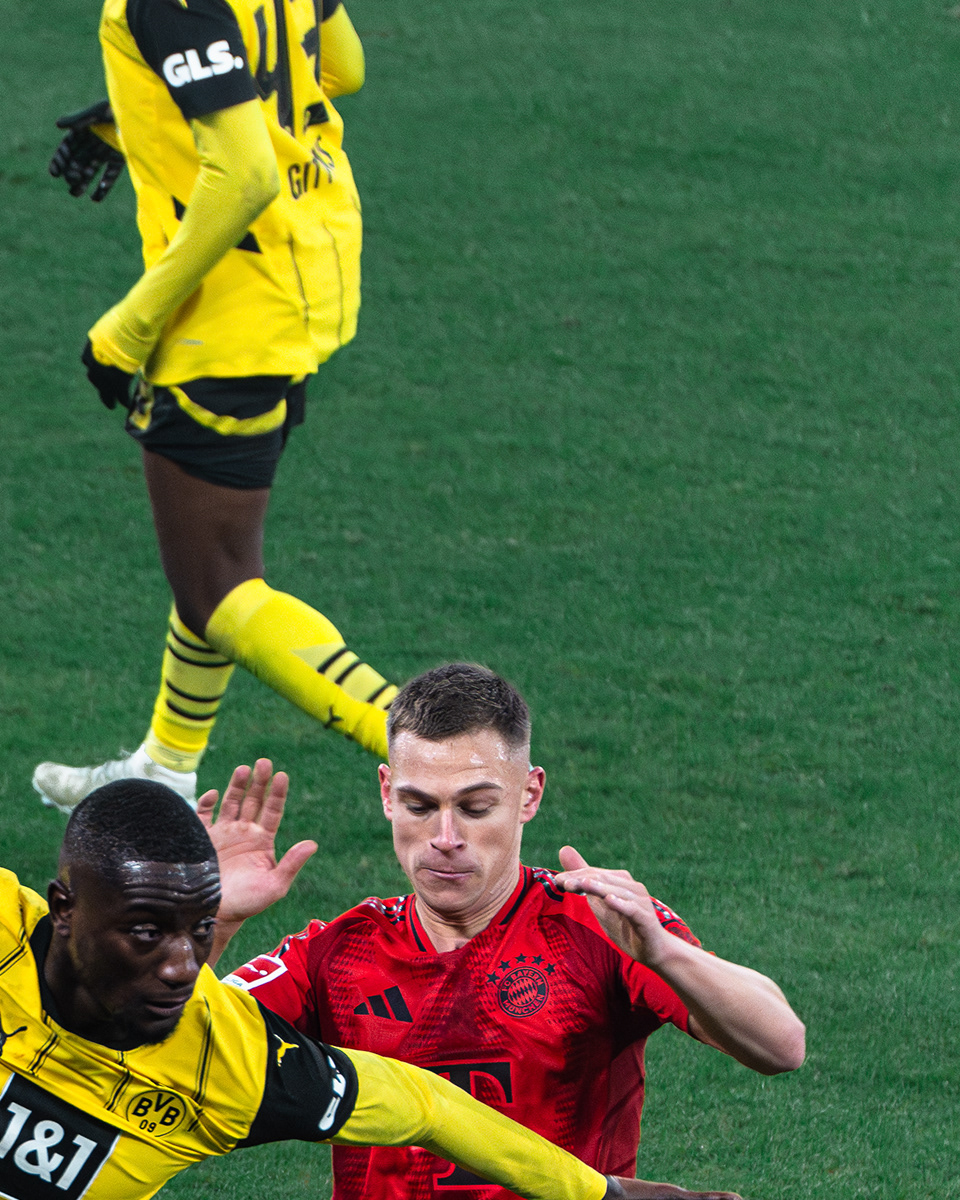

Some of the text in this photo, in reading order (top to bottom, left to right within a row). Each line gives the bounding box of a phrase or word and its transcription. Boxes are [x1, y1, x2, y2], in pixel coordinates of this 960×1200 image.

[162, 40, 244, 88] GLS.
[510, 969, 545, 986] BAYERN
[132, 1092, 181, 1127] BVB
[139, 1118, 157, 1133] 09
